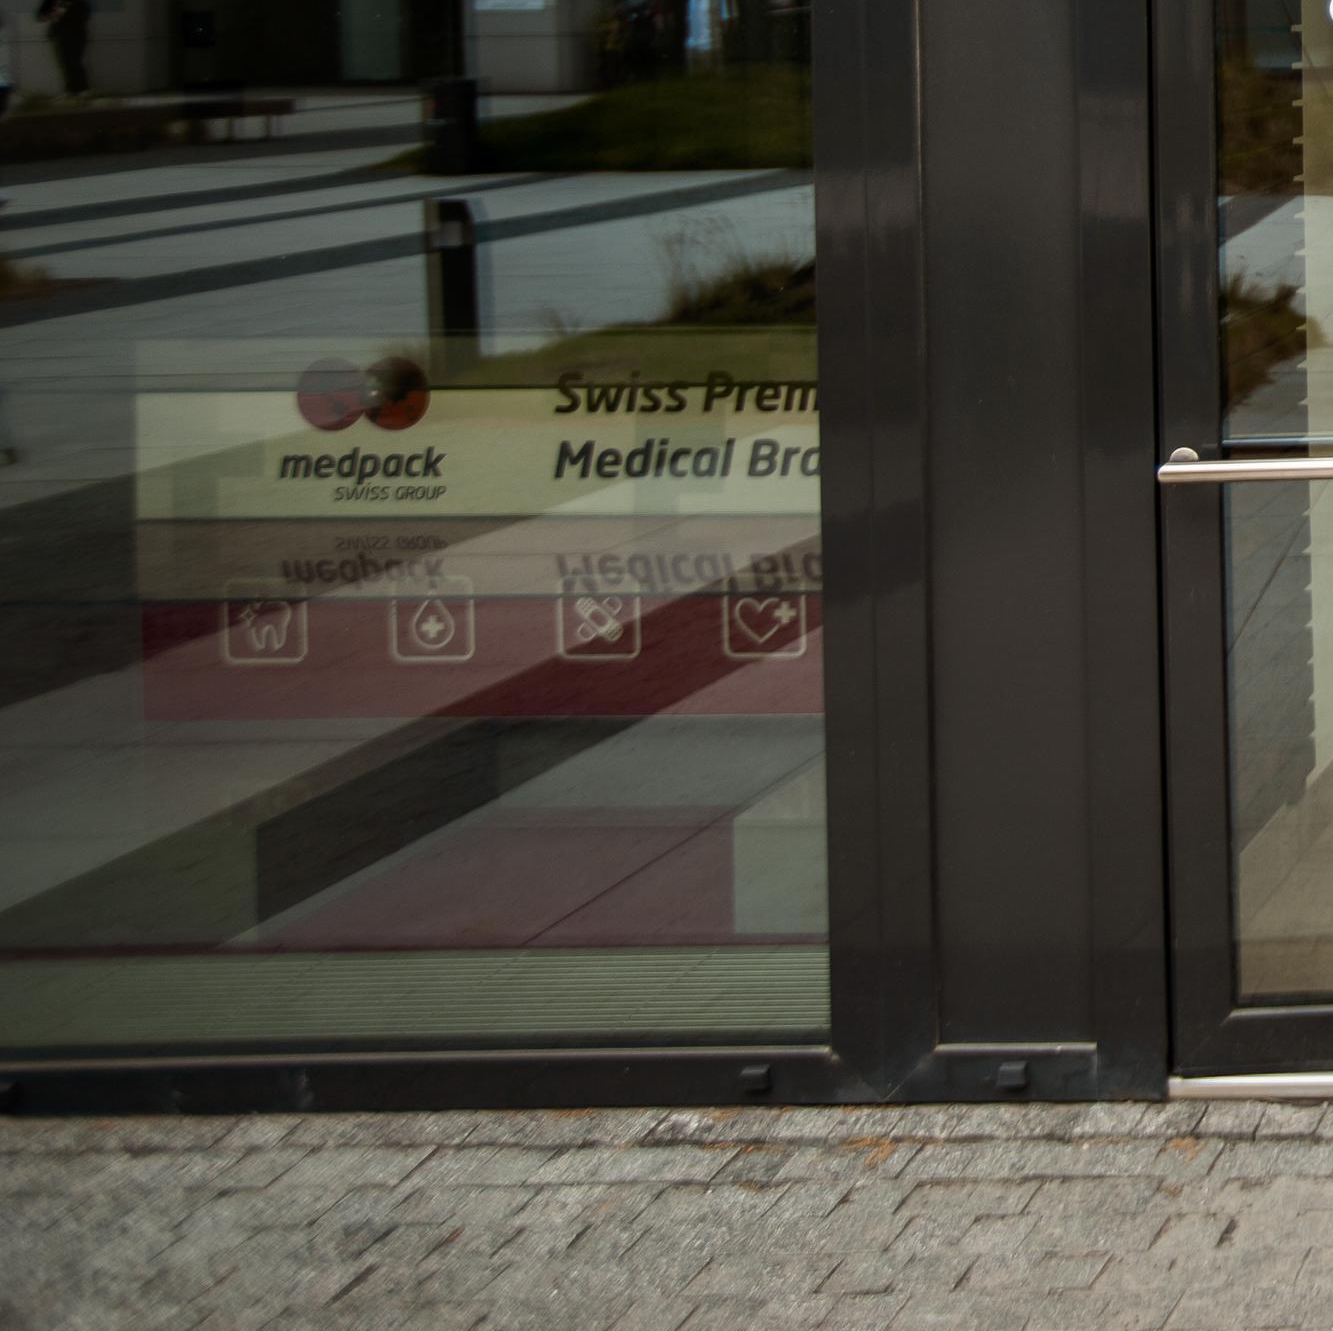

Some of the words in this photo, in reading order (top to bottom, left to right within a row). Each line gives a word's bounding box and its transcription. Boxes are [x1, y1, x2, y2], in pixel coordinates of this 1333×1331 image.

[554, 370, 690, 414] Swiss
[279, 446, 448, 485] medpack
[554, 438, 736, 480] Medical
[395, 485, 447, 501] GROUP
